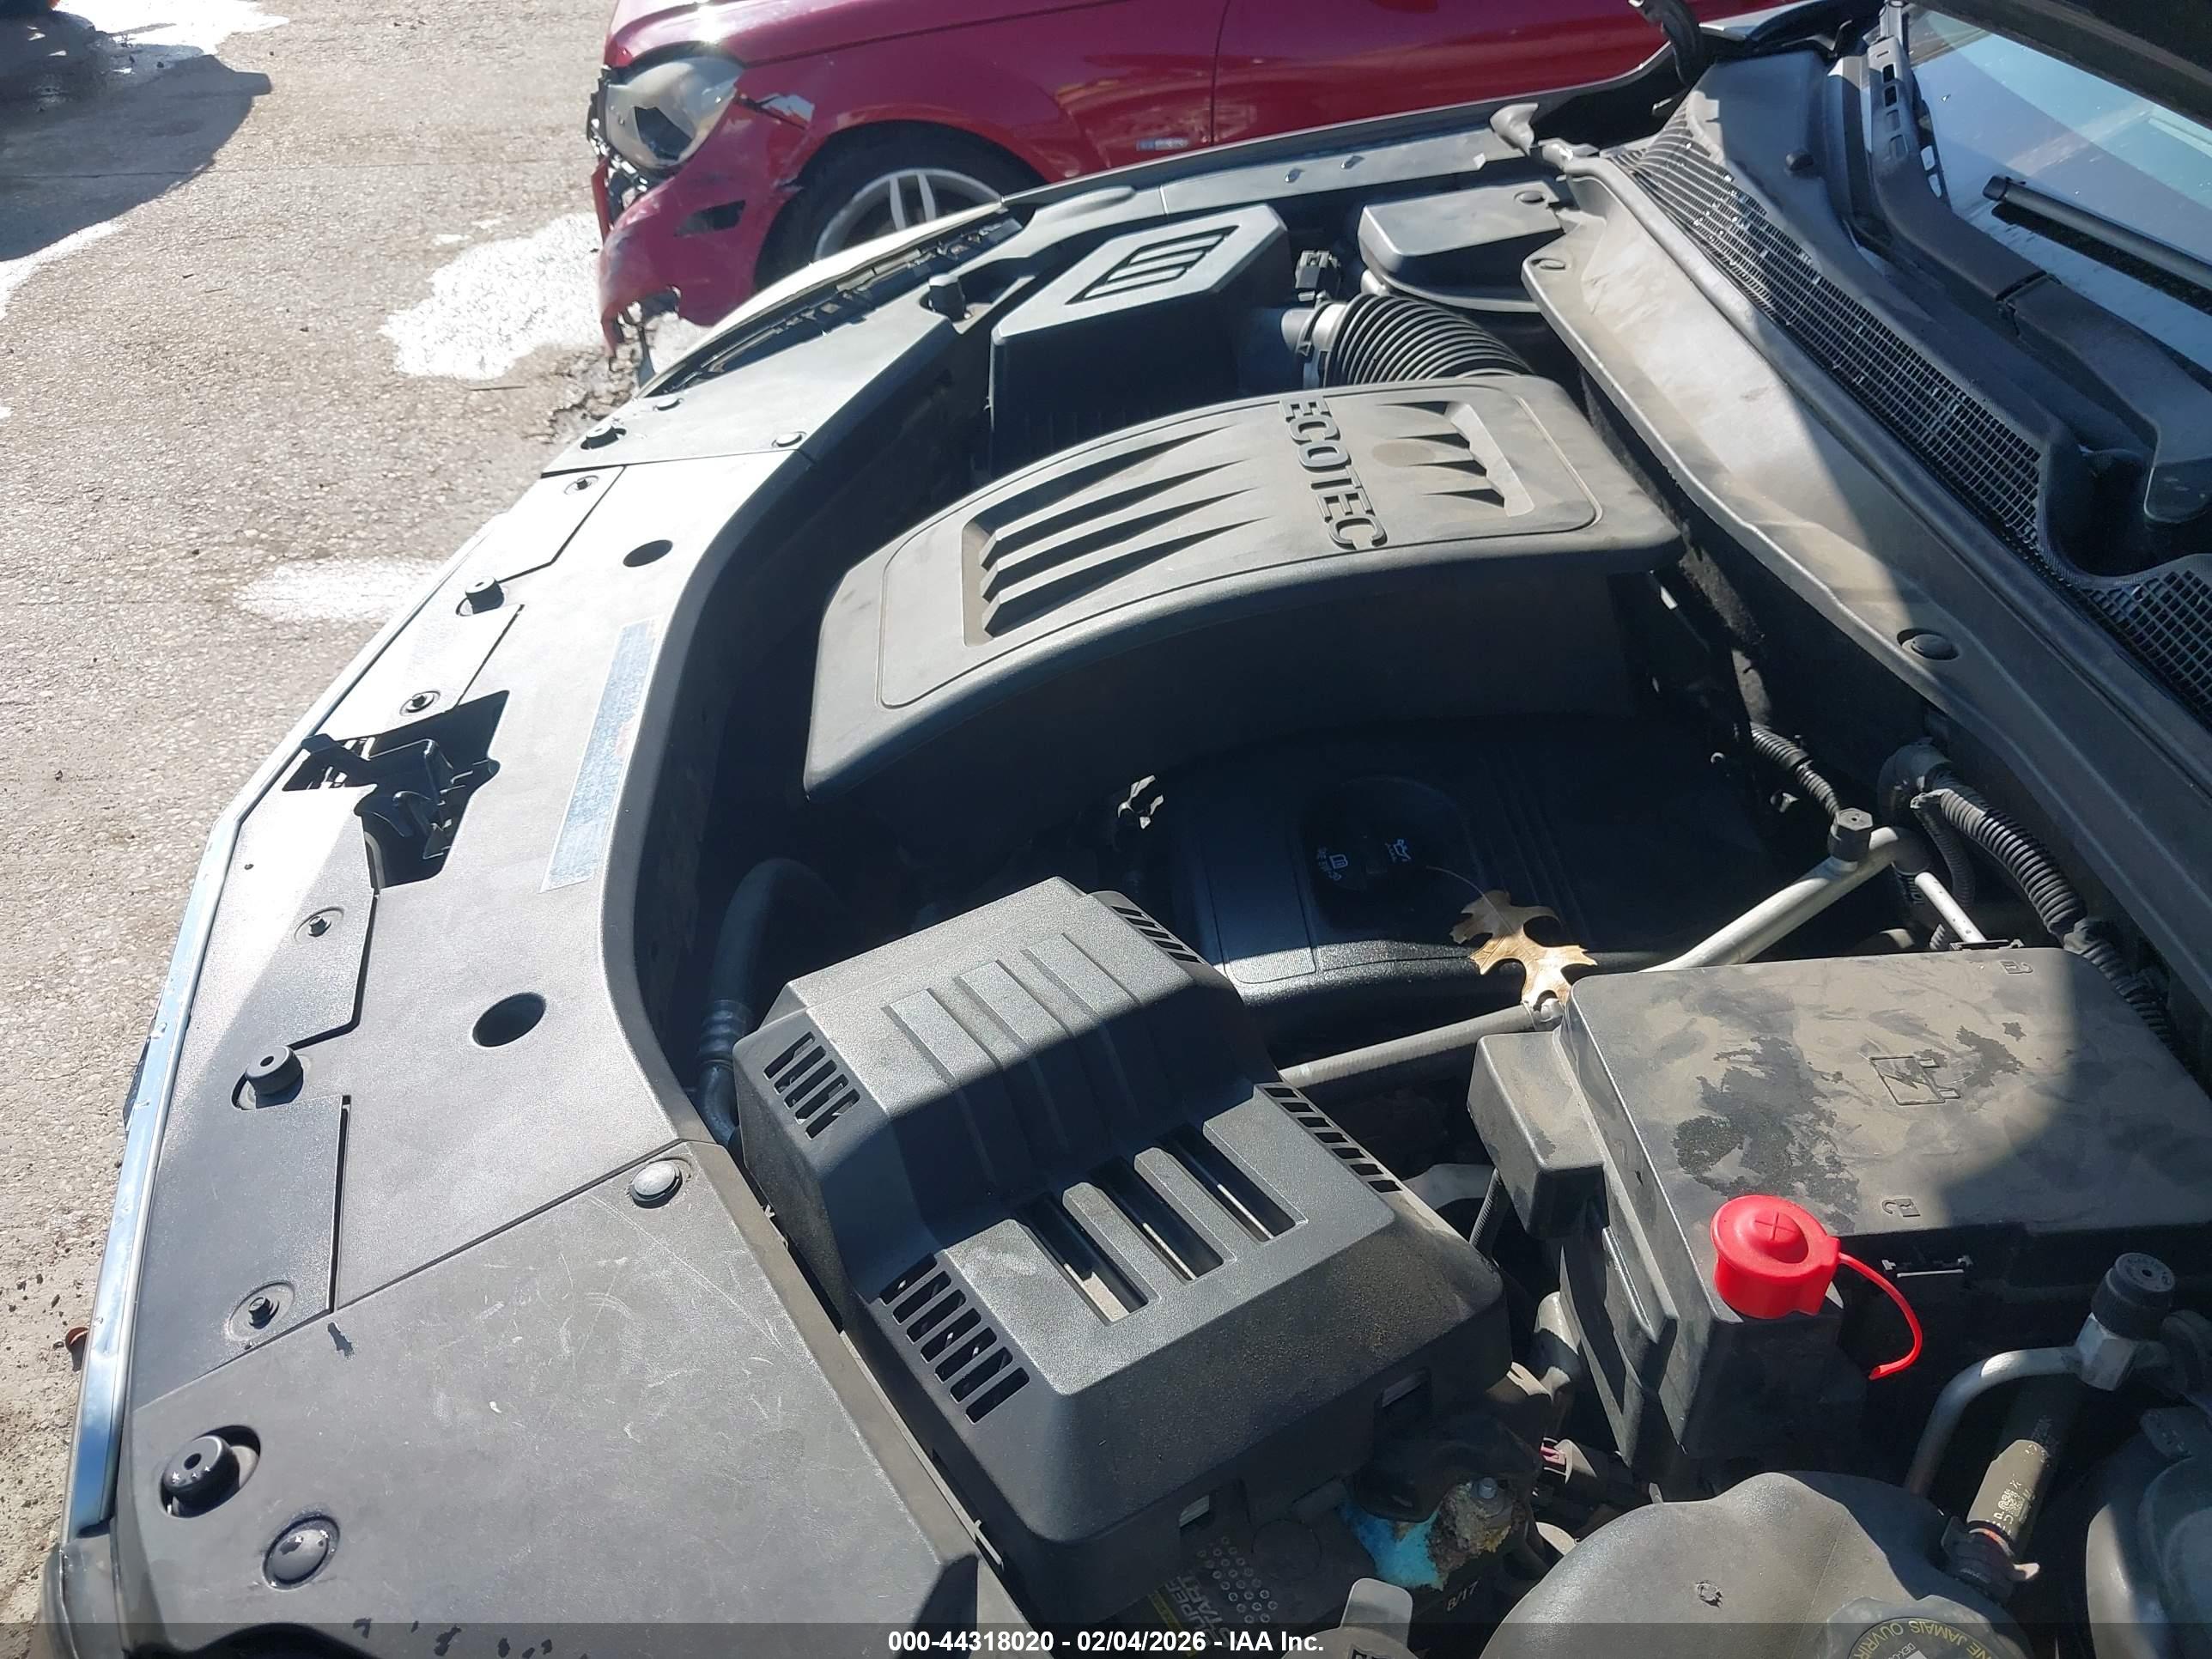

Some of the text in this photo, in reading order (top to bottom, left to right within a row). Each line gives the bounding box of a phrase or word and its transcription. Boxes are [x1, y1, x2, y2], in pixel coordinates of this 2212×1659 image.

[1279, 398, 1388, 550] ECOTEC
[1854, 1623, 1904, 1659] OUVRIR
[1908, 1620, 1967, 1646] JAMAIS
